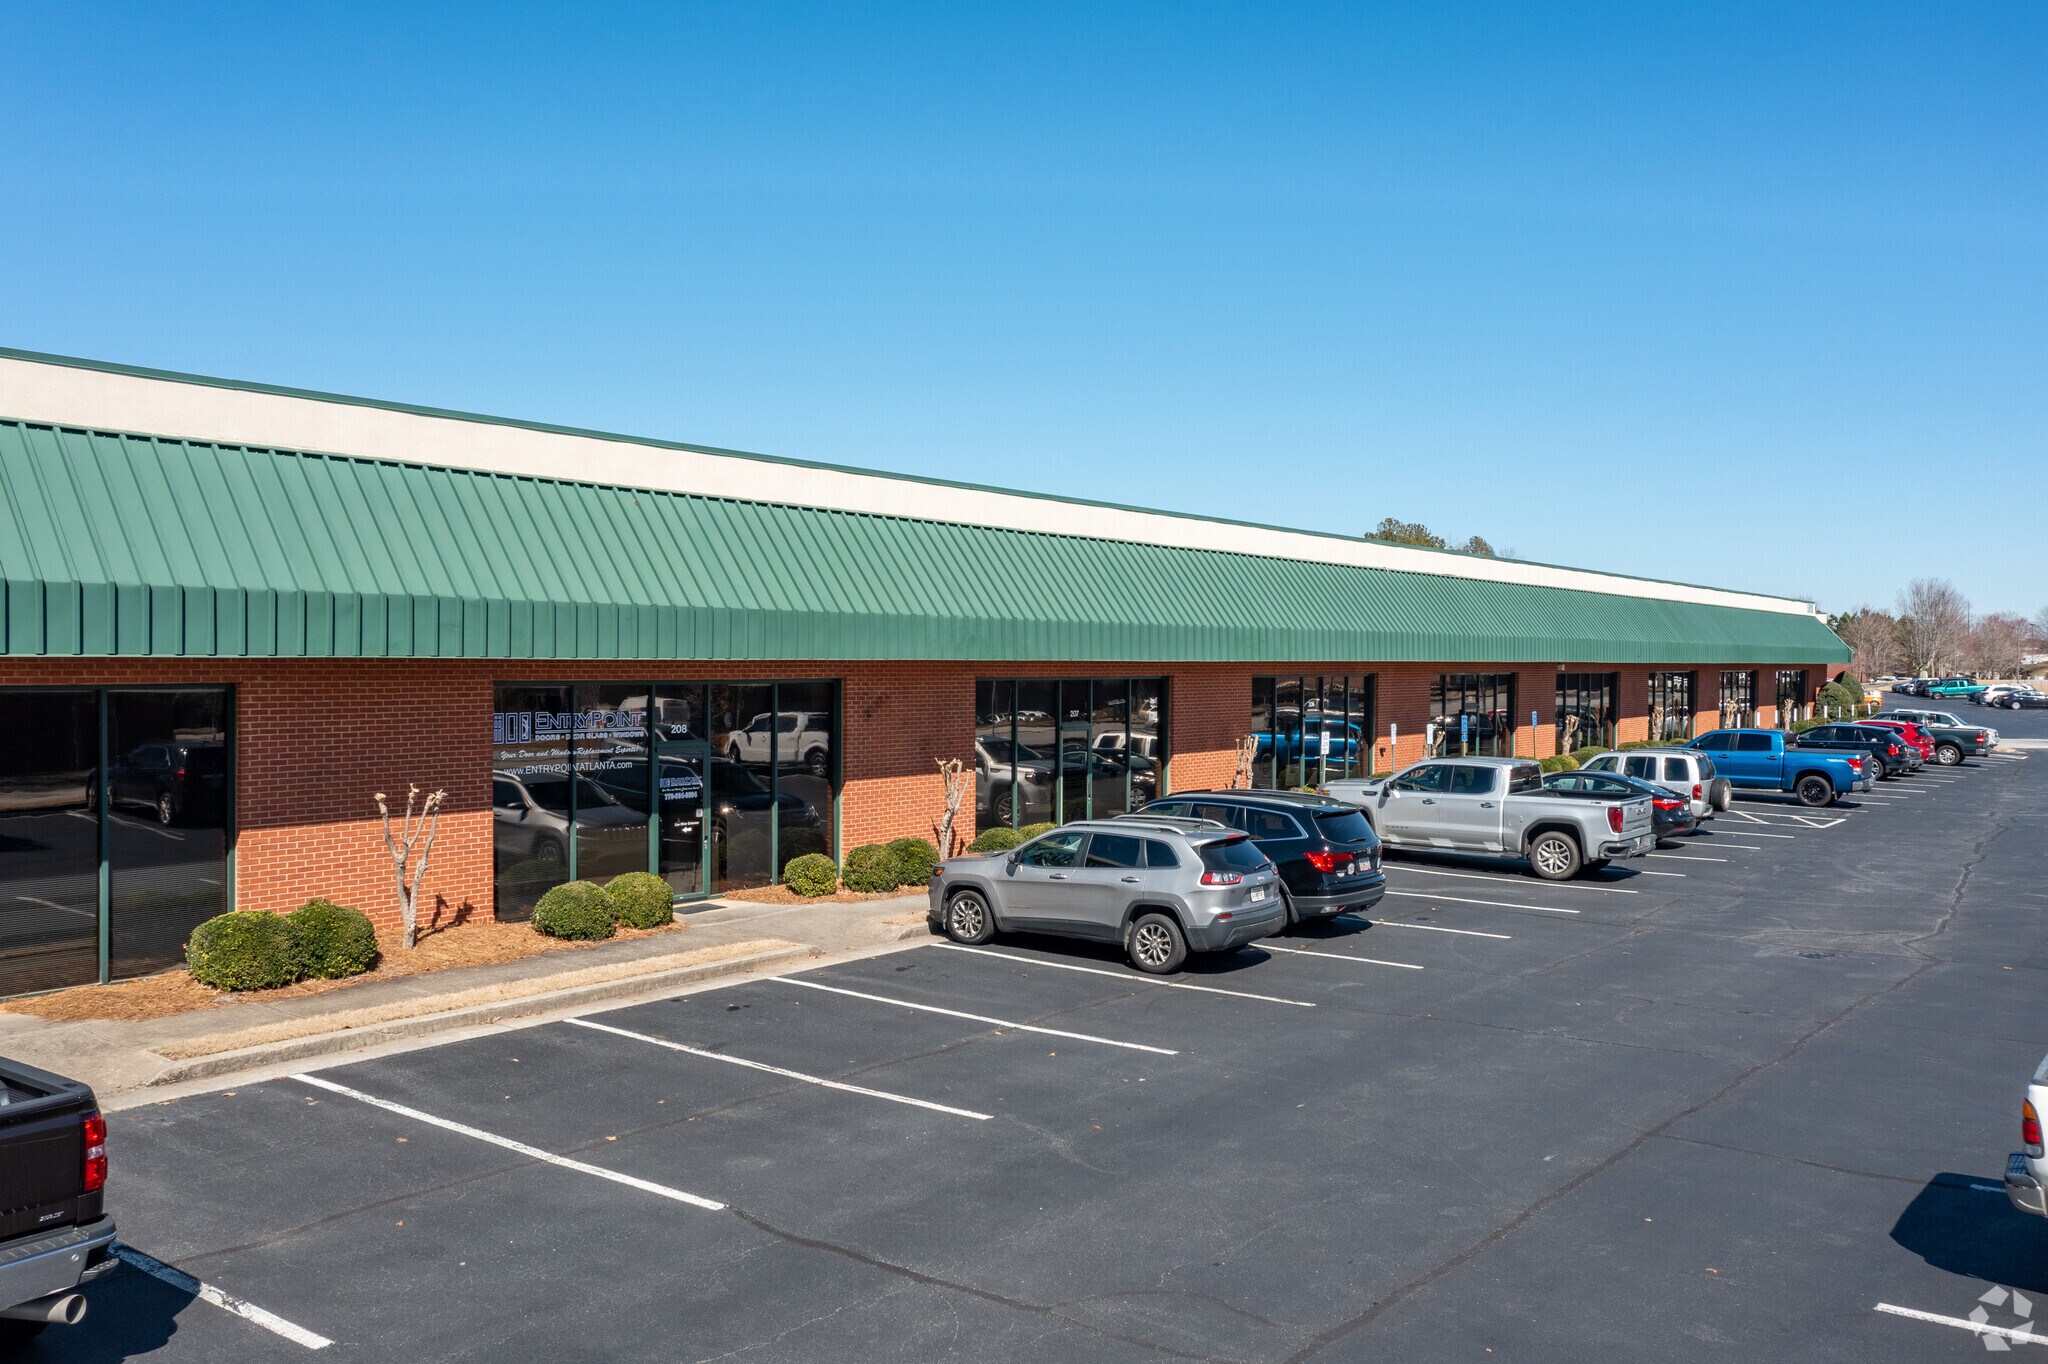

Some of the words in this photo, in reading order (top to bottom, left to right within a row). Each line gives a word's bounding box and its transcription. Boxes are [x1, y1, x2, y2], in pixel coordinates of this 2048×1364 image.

[1069, 710, 1080, 718] 207
[670, 724, 687, 734] 208
[535, 733, 560, 742] DOORS
[586, 731, 608, 740] GLASS
[613, 730, 644, 738] WINDOWS
[500, 750, 516, 760] Your
[518, 749, 535, 758] Door
[576, 746, 614, 756] Replacement
[615, 744, 639, 754] Experts!
[503, 761, 633, 775] www.ENTRYPOINTATLANTA.com
